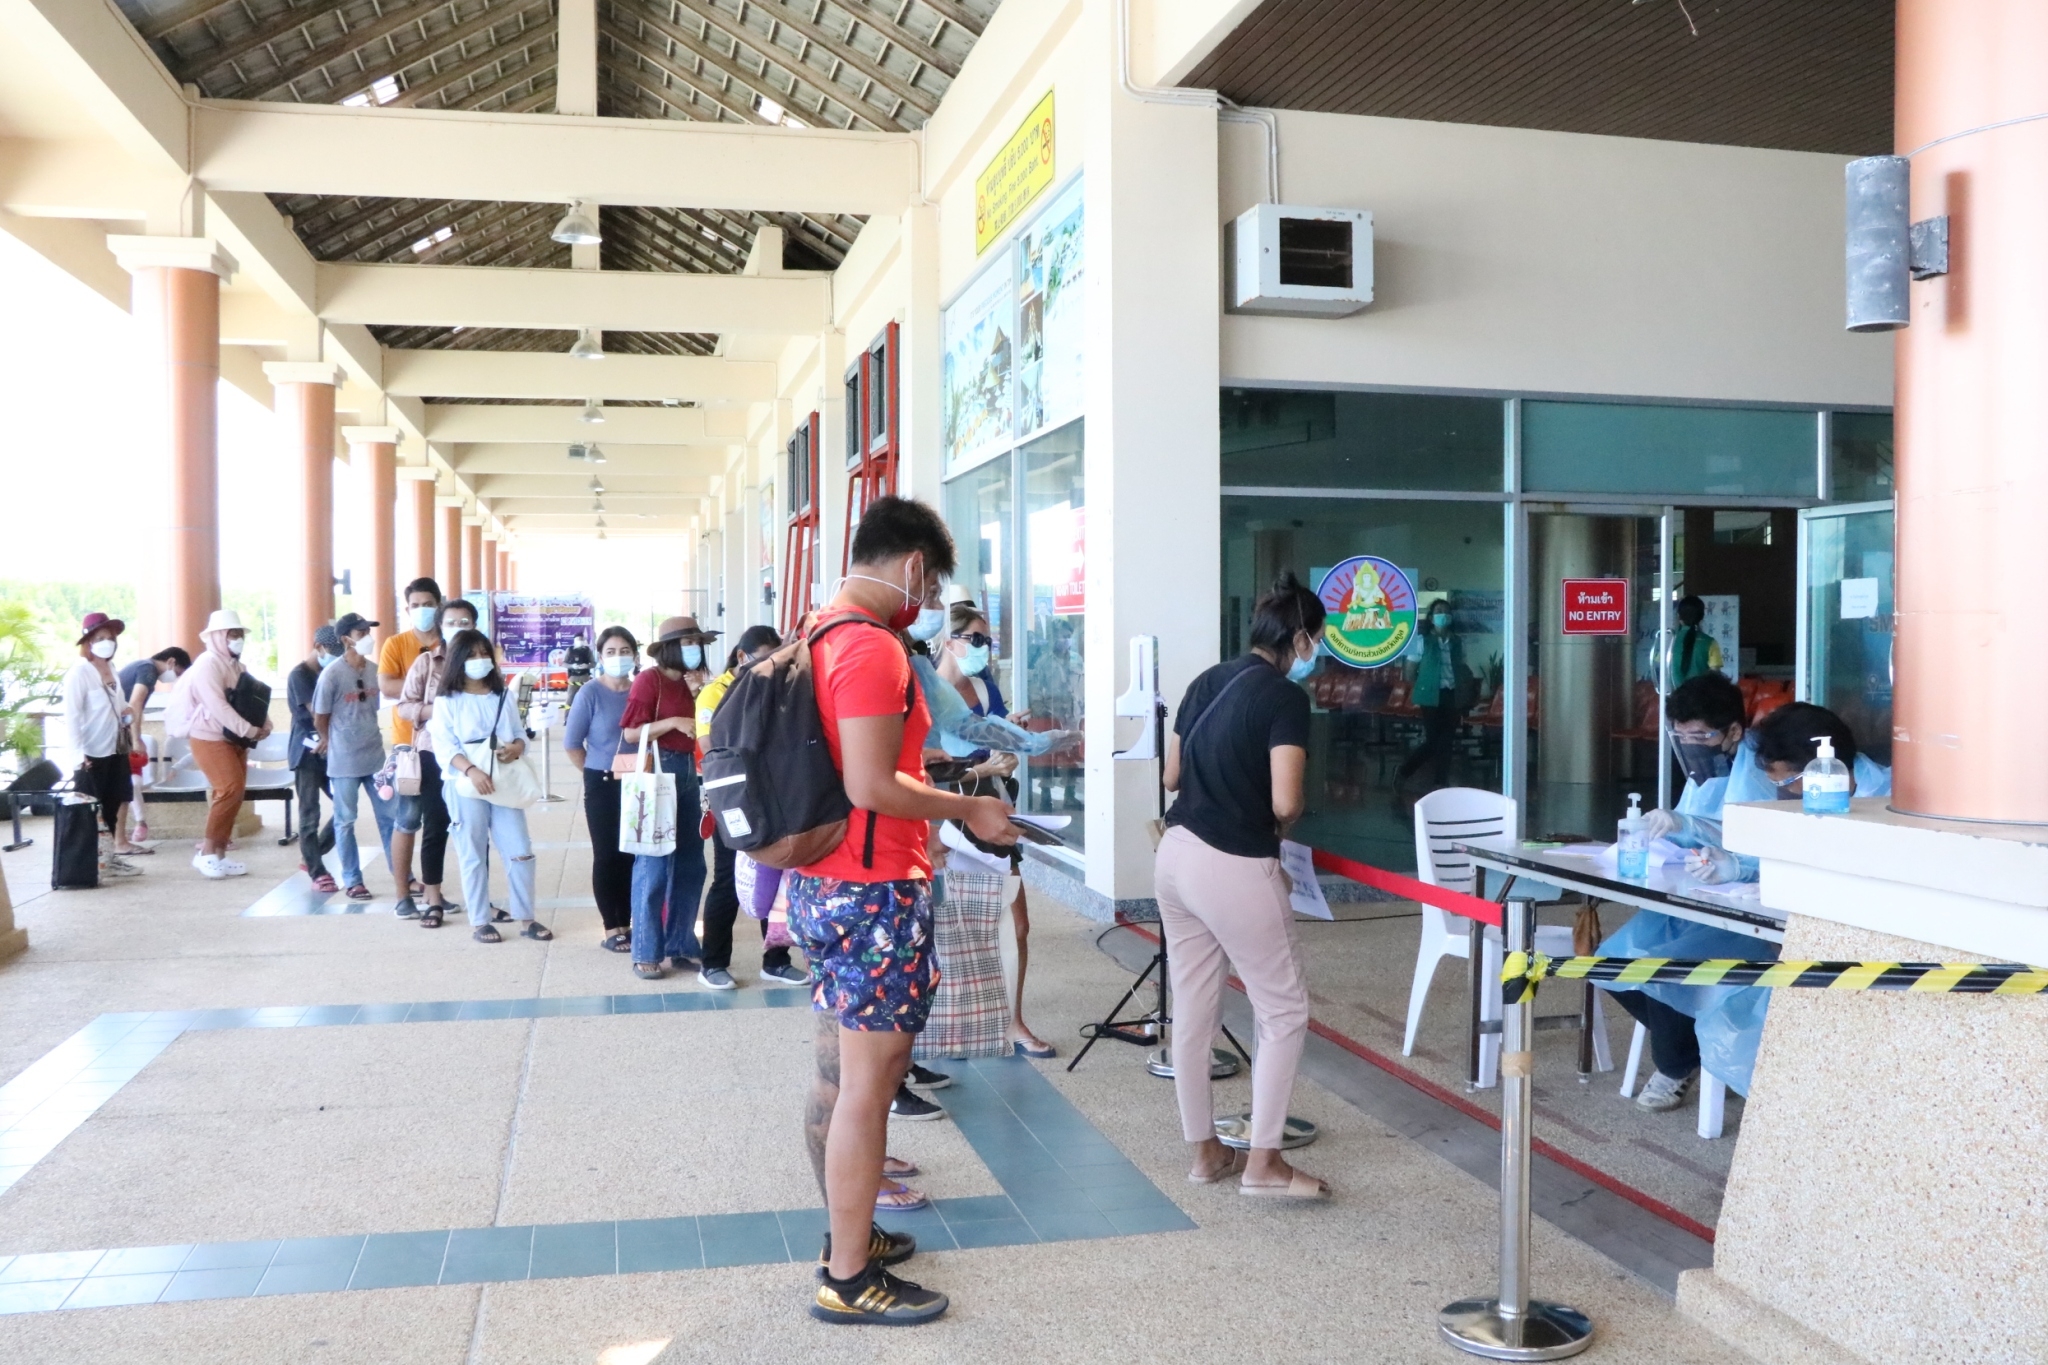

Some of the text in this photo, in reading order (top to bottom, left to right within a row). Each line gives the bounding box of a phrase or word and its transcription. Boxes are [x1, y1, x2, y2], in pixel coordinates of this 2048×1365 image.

[1577, 591, 1613, 605] ห้ามเข้า
[1569, 611, 1621, 621] NO ENTRY
